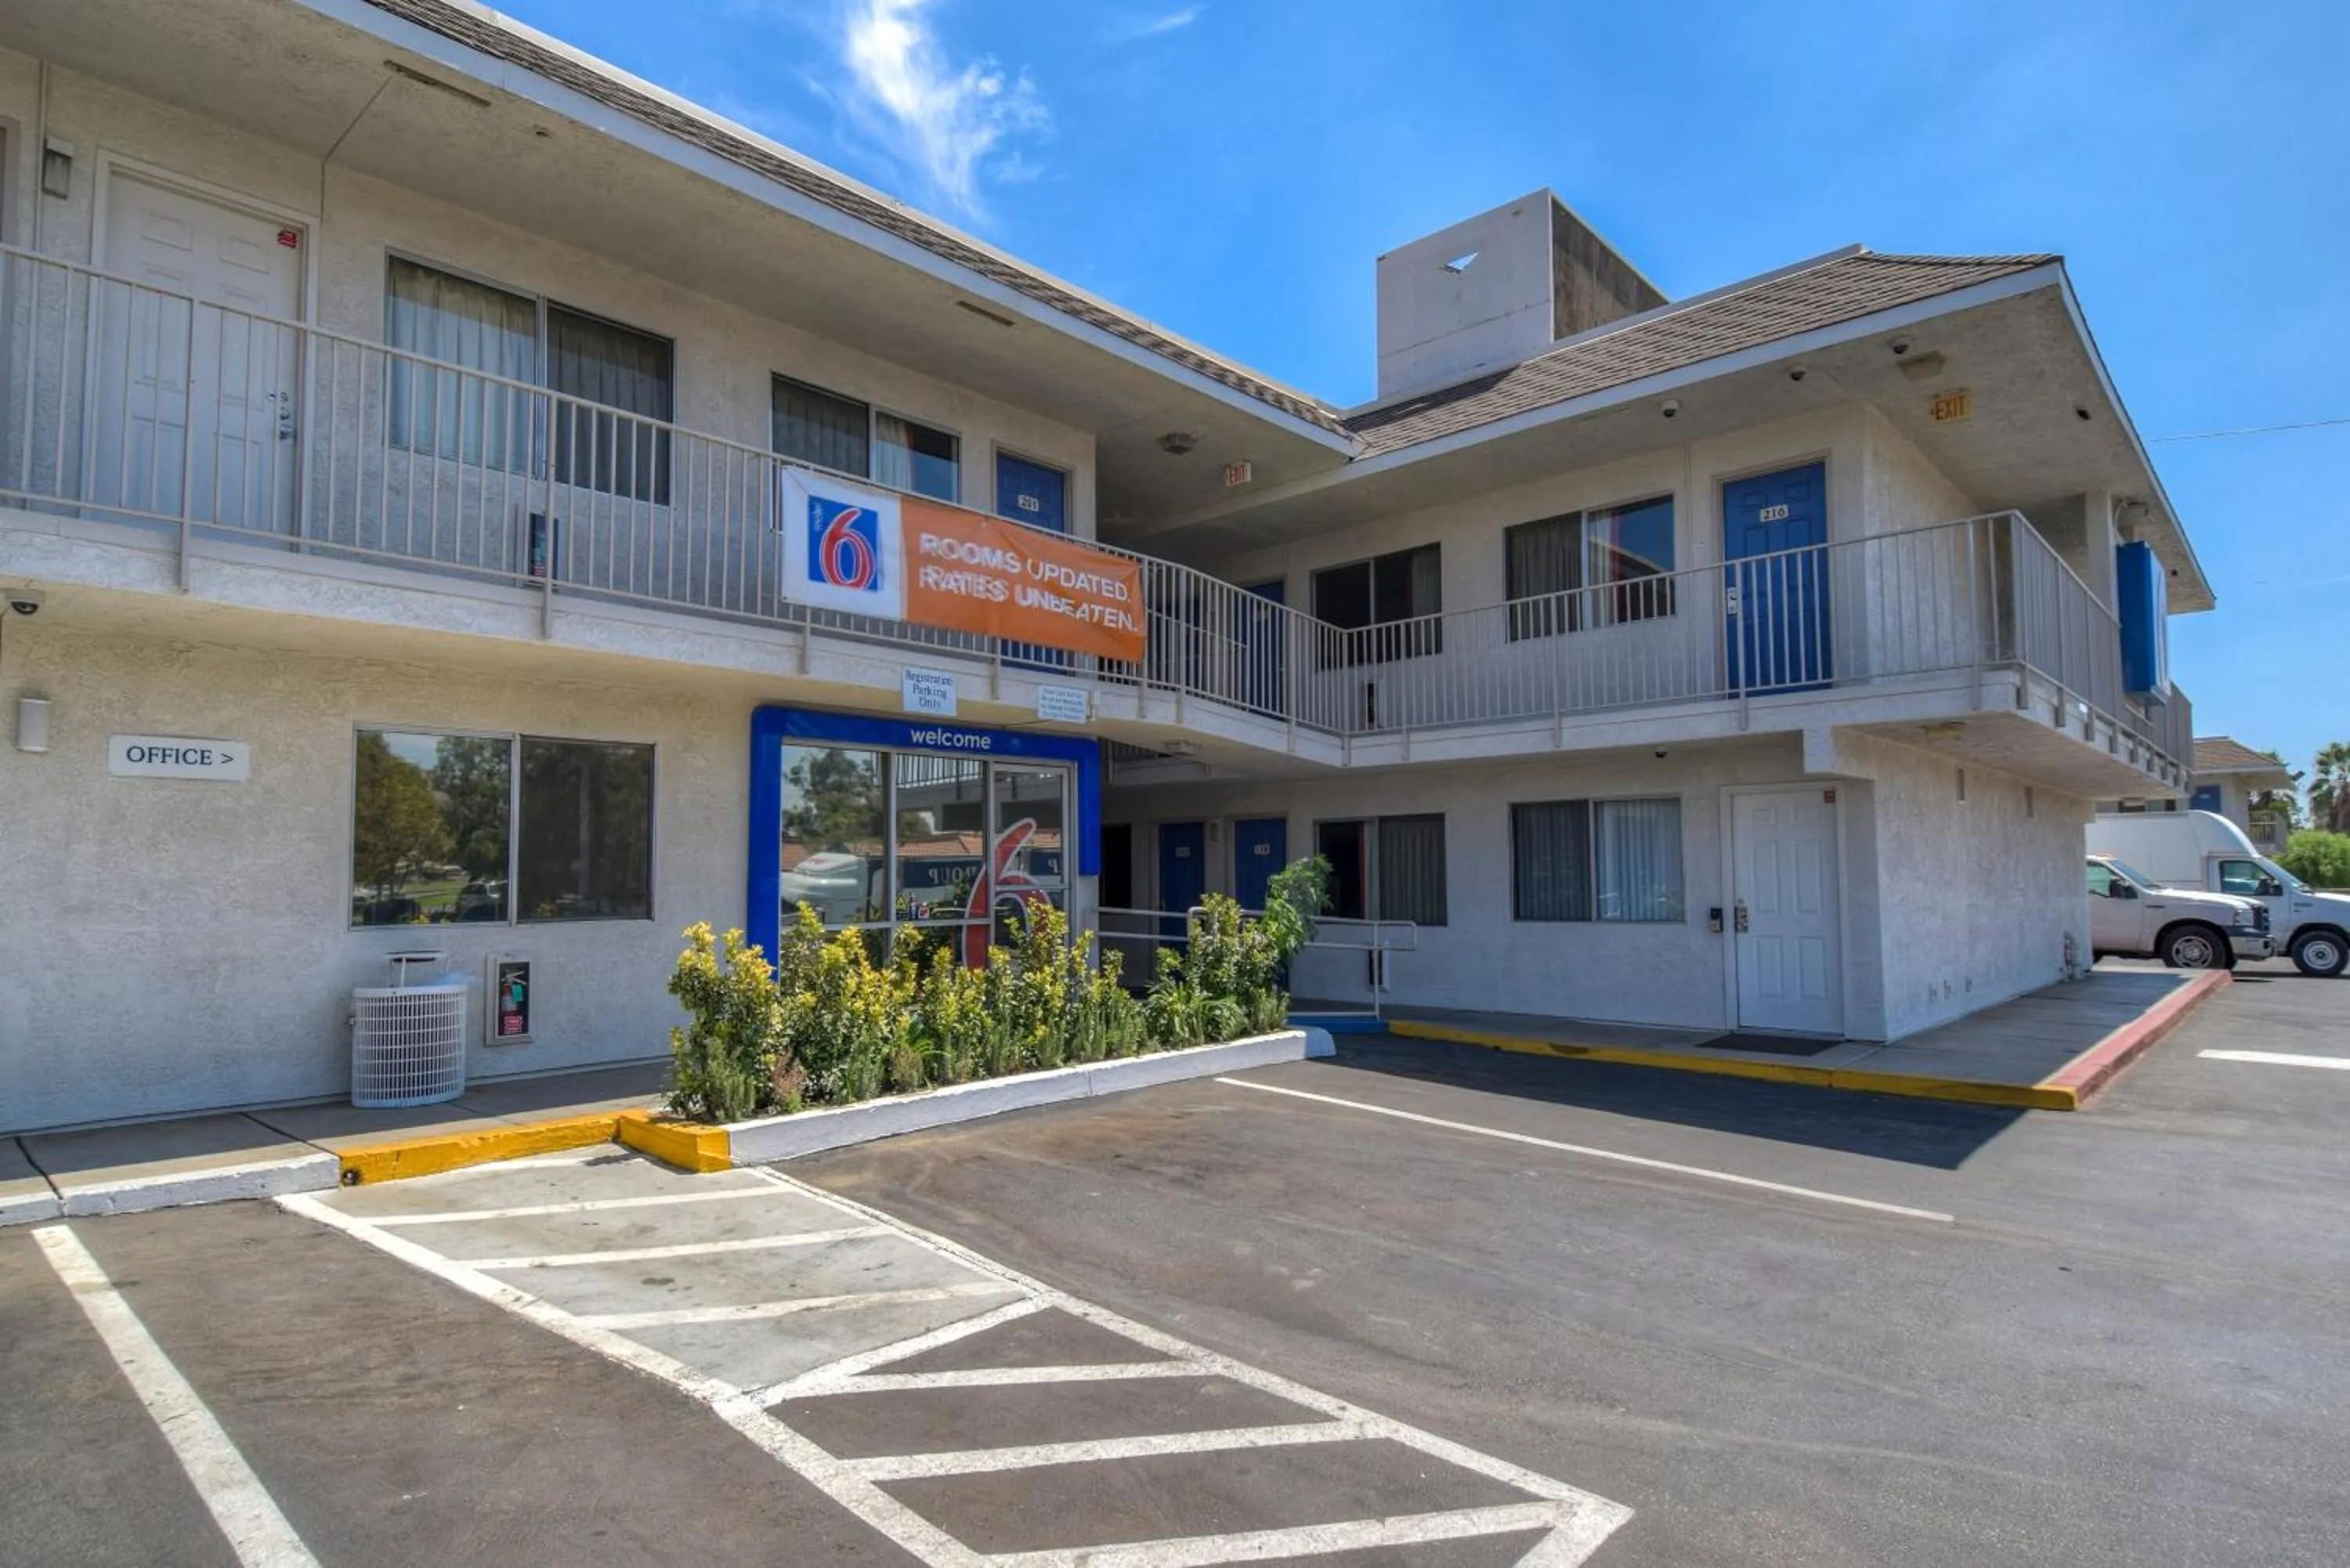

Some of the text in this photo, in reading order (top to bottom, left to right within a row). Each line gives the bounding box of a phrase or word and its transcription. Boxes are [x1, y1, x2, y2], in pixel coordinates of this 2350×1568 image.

[1936, 396, 1965, 420] EXIT
[1229, 464, 1246, 485] EXIT
[819, 508, 877, 590] 6
[920, 533, 1131, 602] ROOMS UPDATED.
[919, 565, 1138, 631] RATES UNBEATEN.
[913, 683, 947, 699] Parking
[919, 696, 942, 709] Only
[910, 728, 991, 749] welcome
[126, 745, 213, 765] OFFICE
